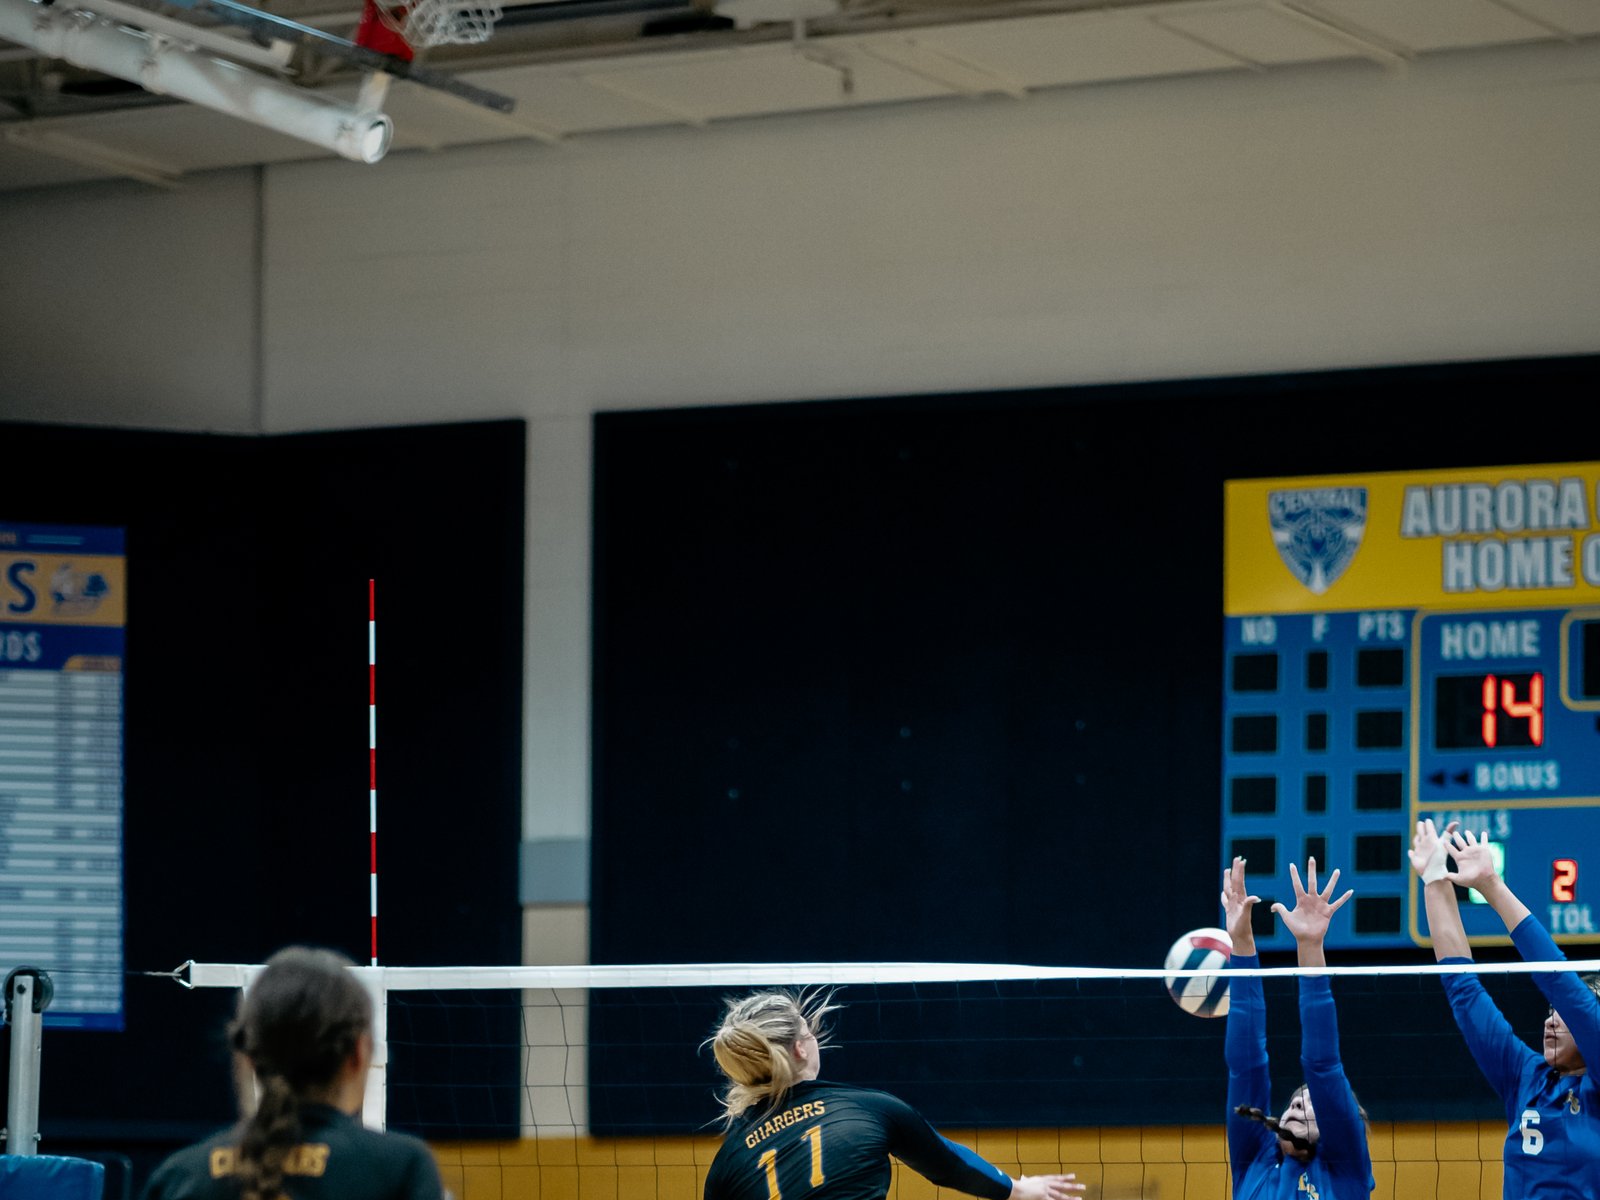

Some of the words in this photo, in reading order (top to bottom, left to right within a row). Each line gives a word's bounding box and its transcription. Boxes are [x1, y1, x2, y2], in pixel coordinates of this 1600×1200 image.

[1401, 477, 1590, 538] AURORA
[1443, 536, 1575, 592] HOME
[1241, 616, 1277, 645] NO
[1312, 614, 1328, 641] F
[1358, 611, 1404, 640] PTS
[1441, 620, 1541, 659] HOME
[1482, 672, 1544, 748] 14
[1475, 761, 1559, 791] BONUS
[1553, 859, 1578, 902] 2
[1549, 904, 1594, 933] TOL
[745, 1100, 826, 1149] CHARGERS
[1519, 1109, 1544, 1156] 6
